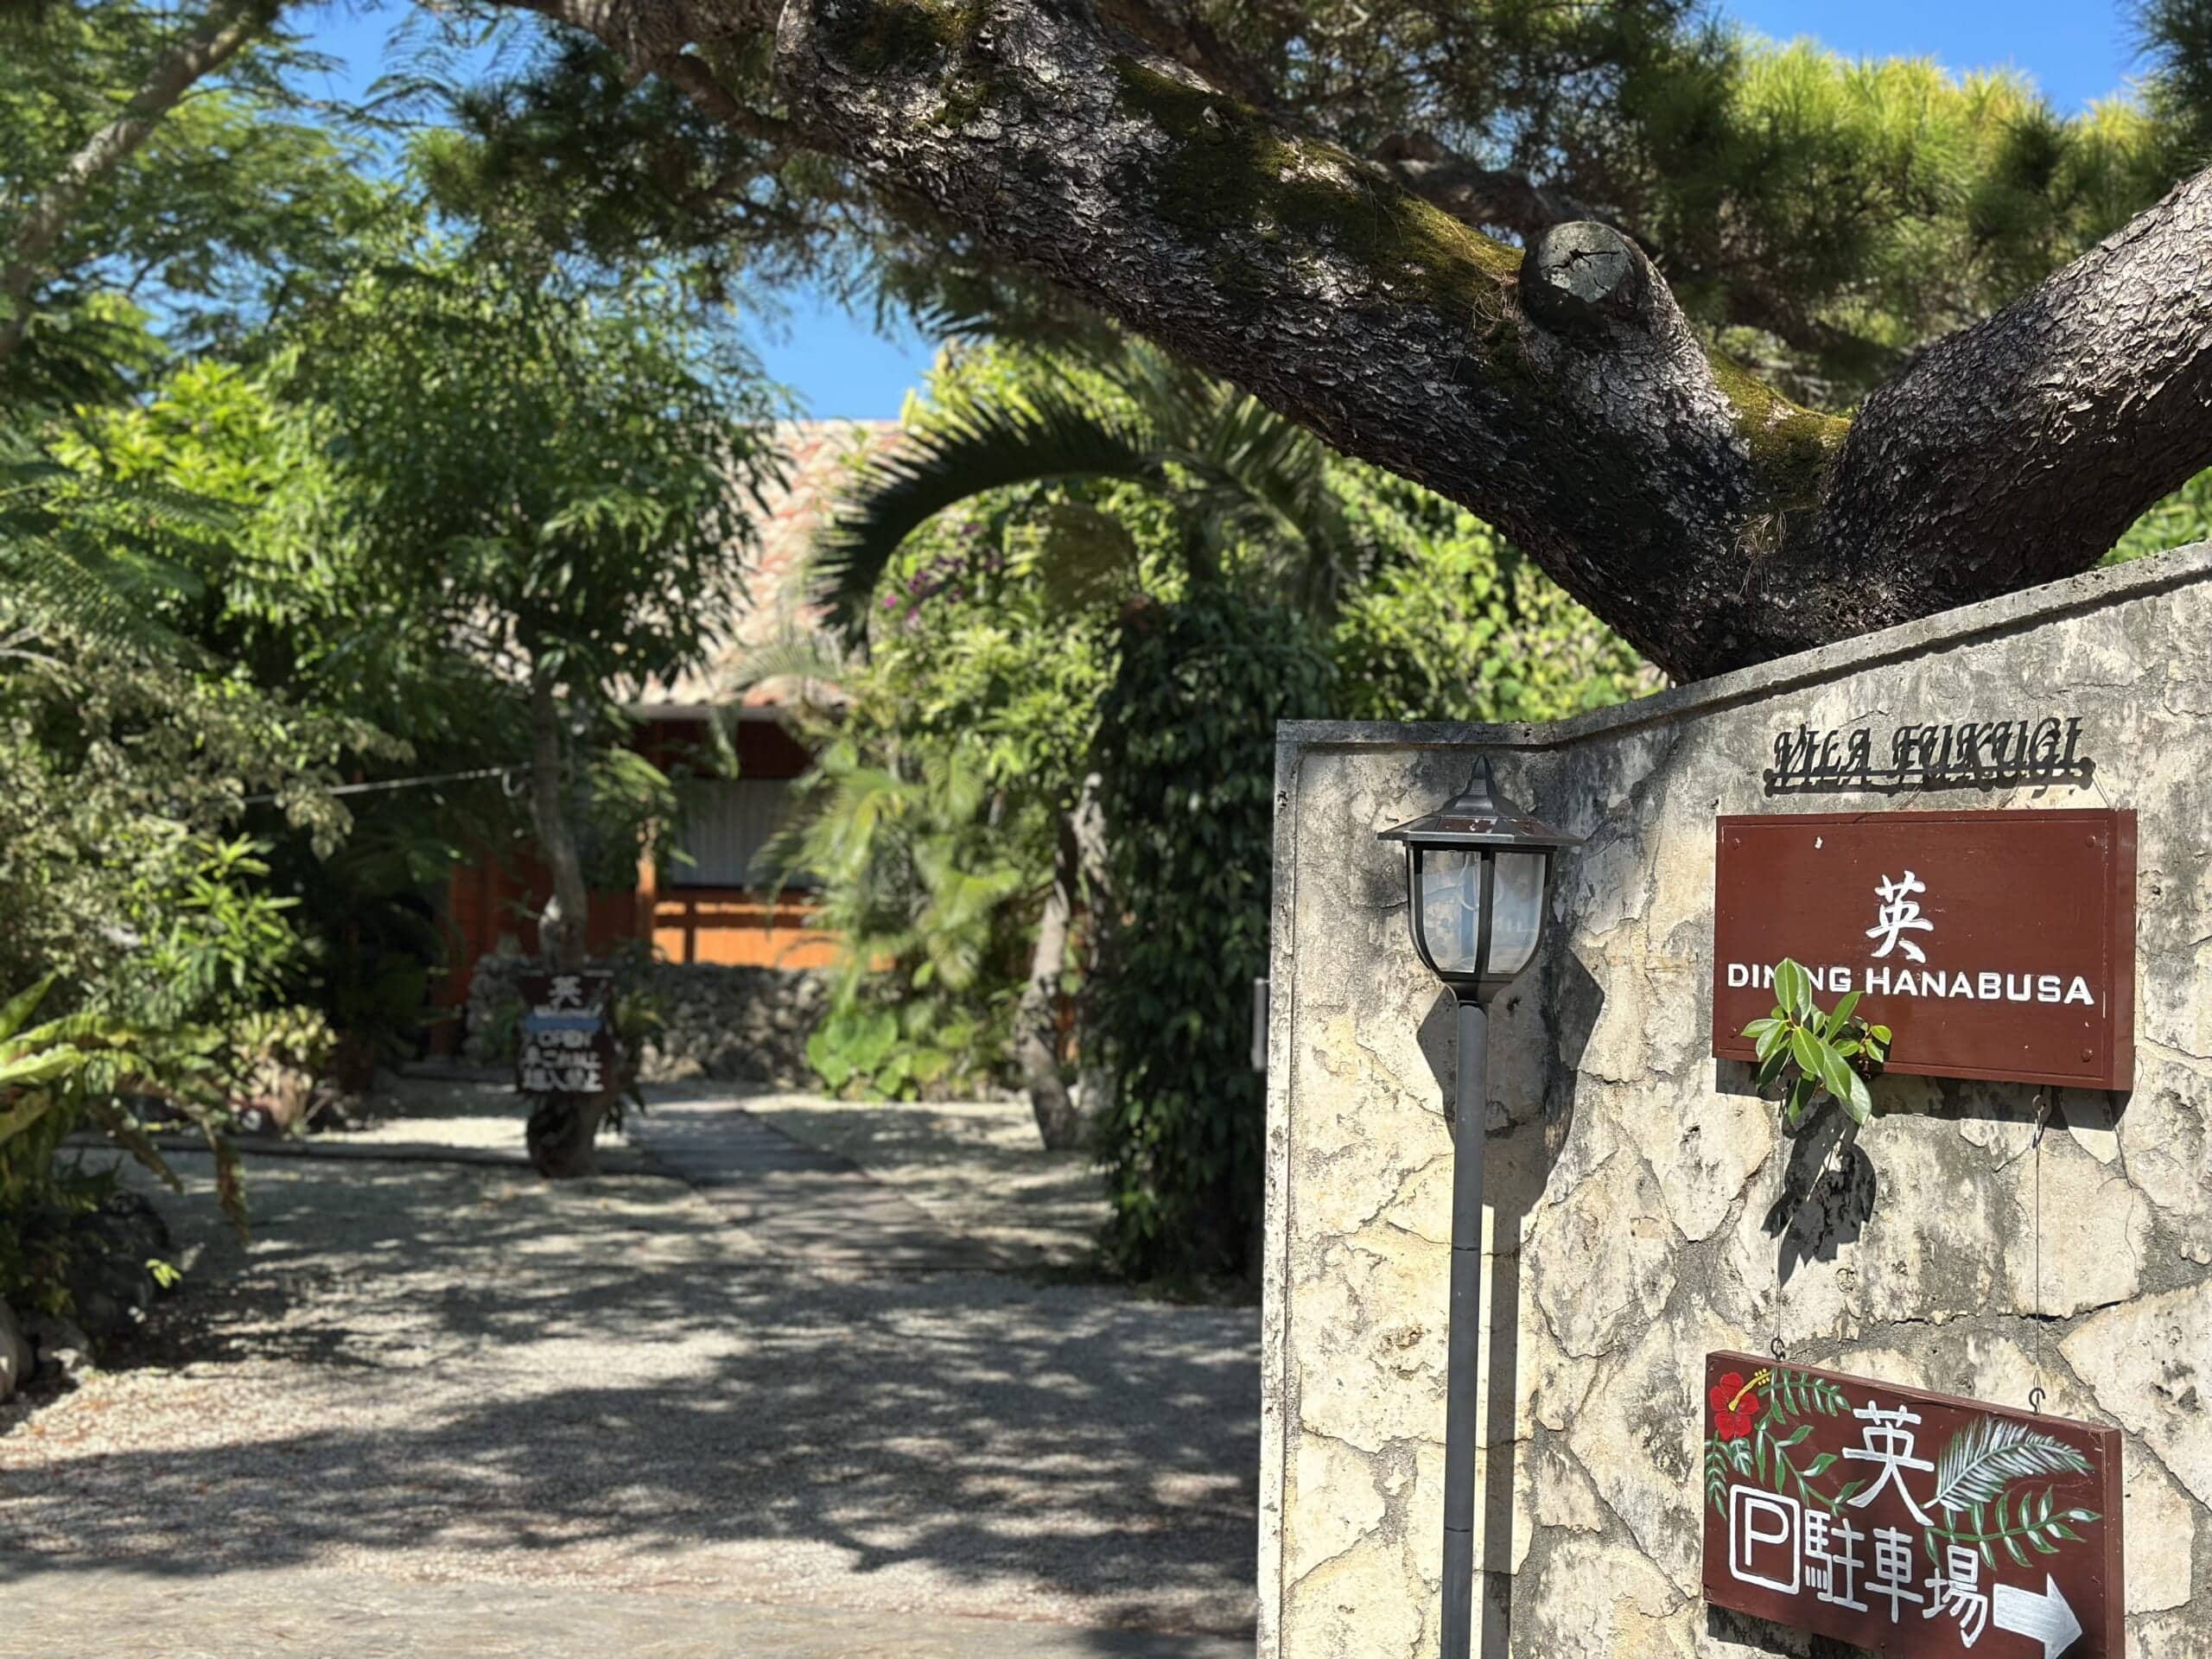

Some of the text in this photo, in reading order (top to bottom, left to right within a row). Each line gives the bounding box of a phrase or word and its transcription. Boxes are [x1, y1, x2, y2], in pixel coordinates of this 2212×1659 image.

[1891, 716, 2084, 774] FUKUGI
[1866, 870, 1934, 963] 英
[1865, 966, 2094, 1006] HANABUSA
[1842, 1401, 1935, 1525] 英
